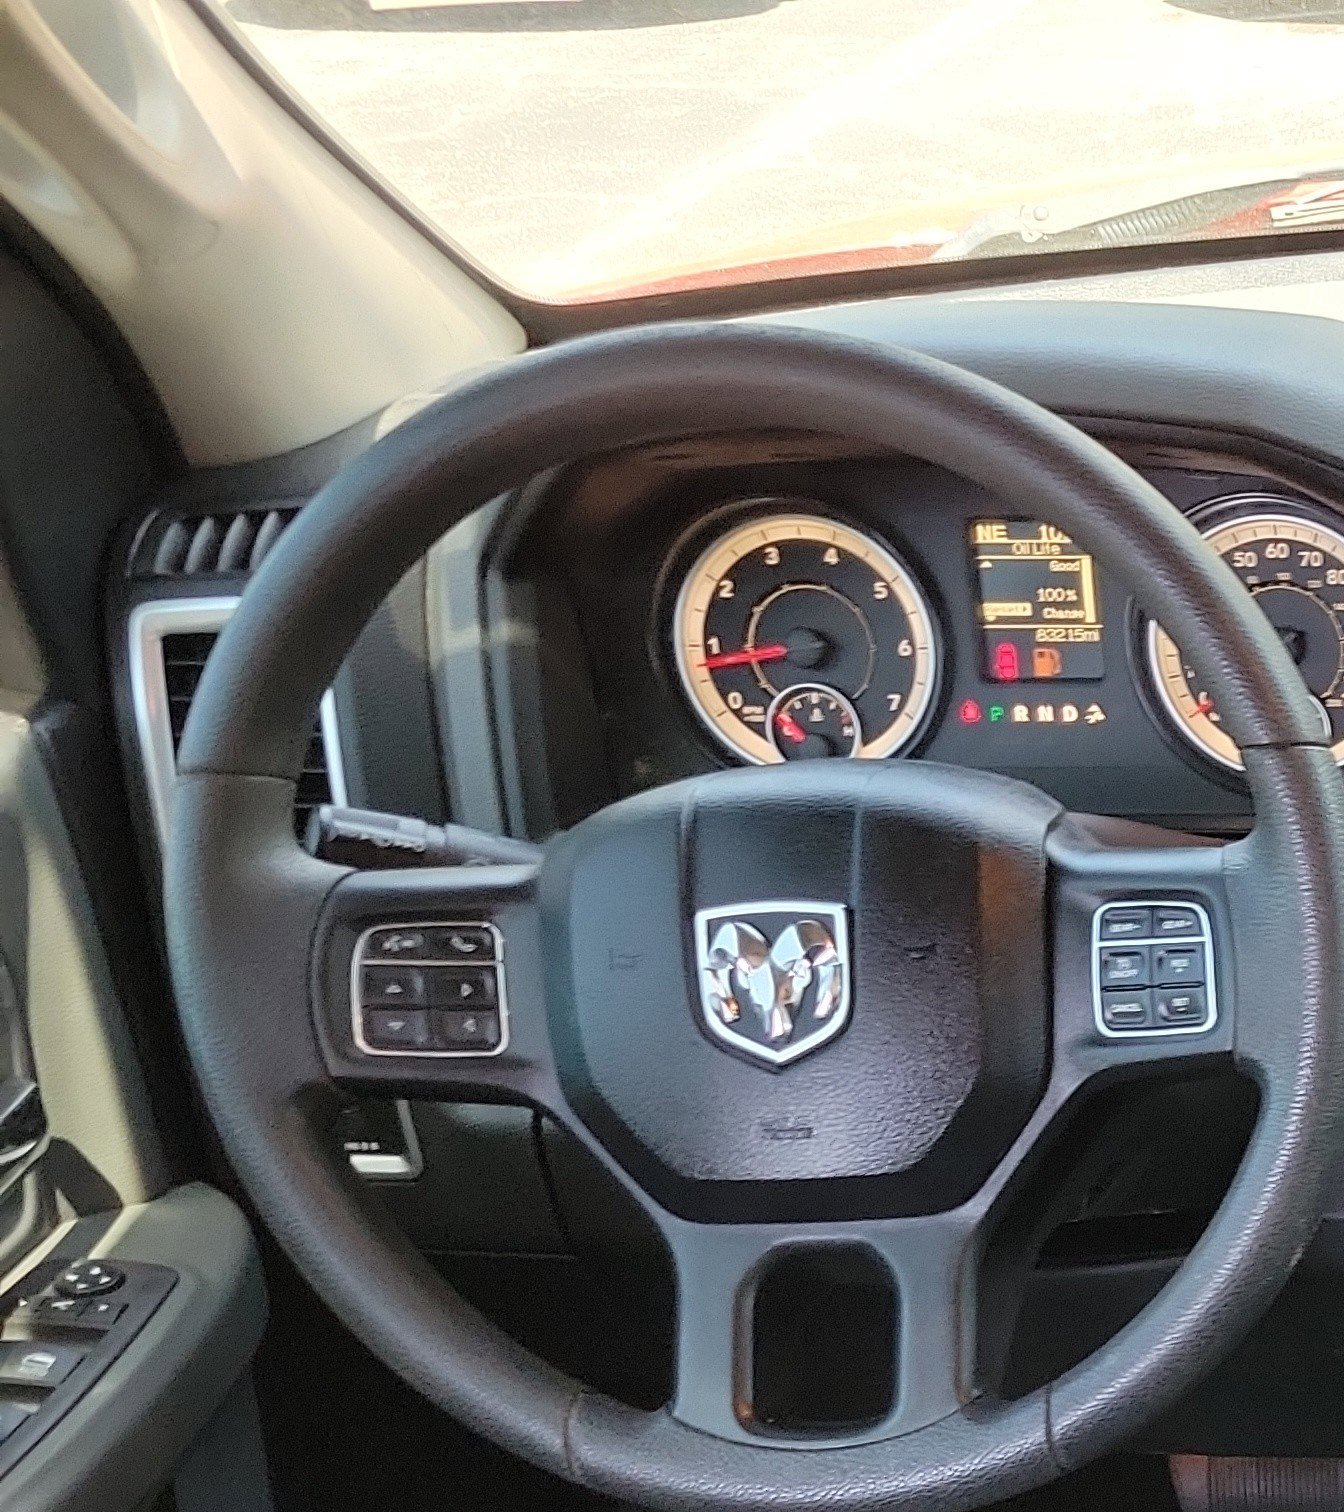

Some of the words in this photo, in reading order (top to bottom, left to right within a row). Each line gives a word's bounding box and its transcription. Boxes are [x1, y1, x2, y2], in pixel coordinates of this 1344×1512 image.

[975, 525, 1007, 540] NE
[764, 548, 780, 565] 3
[823, 548, 840, 565] 4
[1012, 543, 1030, 555] Oil
[1032, 543, 1060, 555] Life
[1265, 543, 1290, 559] 60
[1049, 560, 1080, 572] Good
[1232, 551, 1258, 567] 50
[1297, 551, 1324, 567] 70
[718, 580, 735, 598] 2
[873, 582, 889, 599] 5
[1036, 587, 1078, 602] 100%
[707, 636, 721, 654] 1
[898, 640, 912, 657] 6
[727, 691, 743, 709] 0
[887, 694, 901, 711] 7
[989, 706, 1004, 721] P
[1013, 704, 1031, 722] R
[1037, 705, 1054, 722] N
[1062, 705, 1079, 722] D
